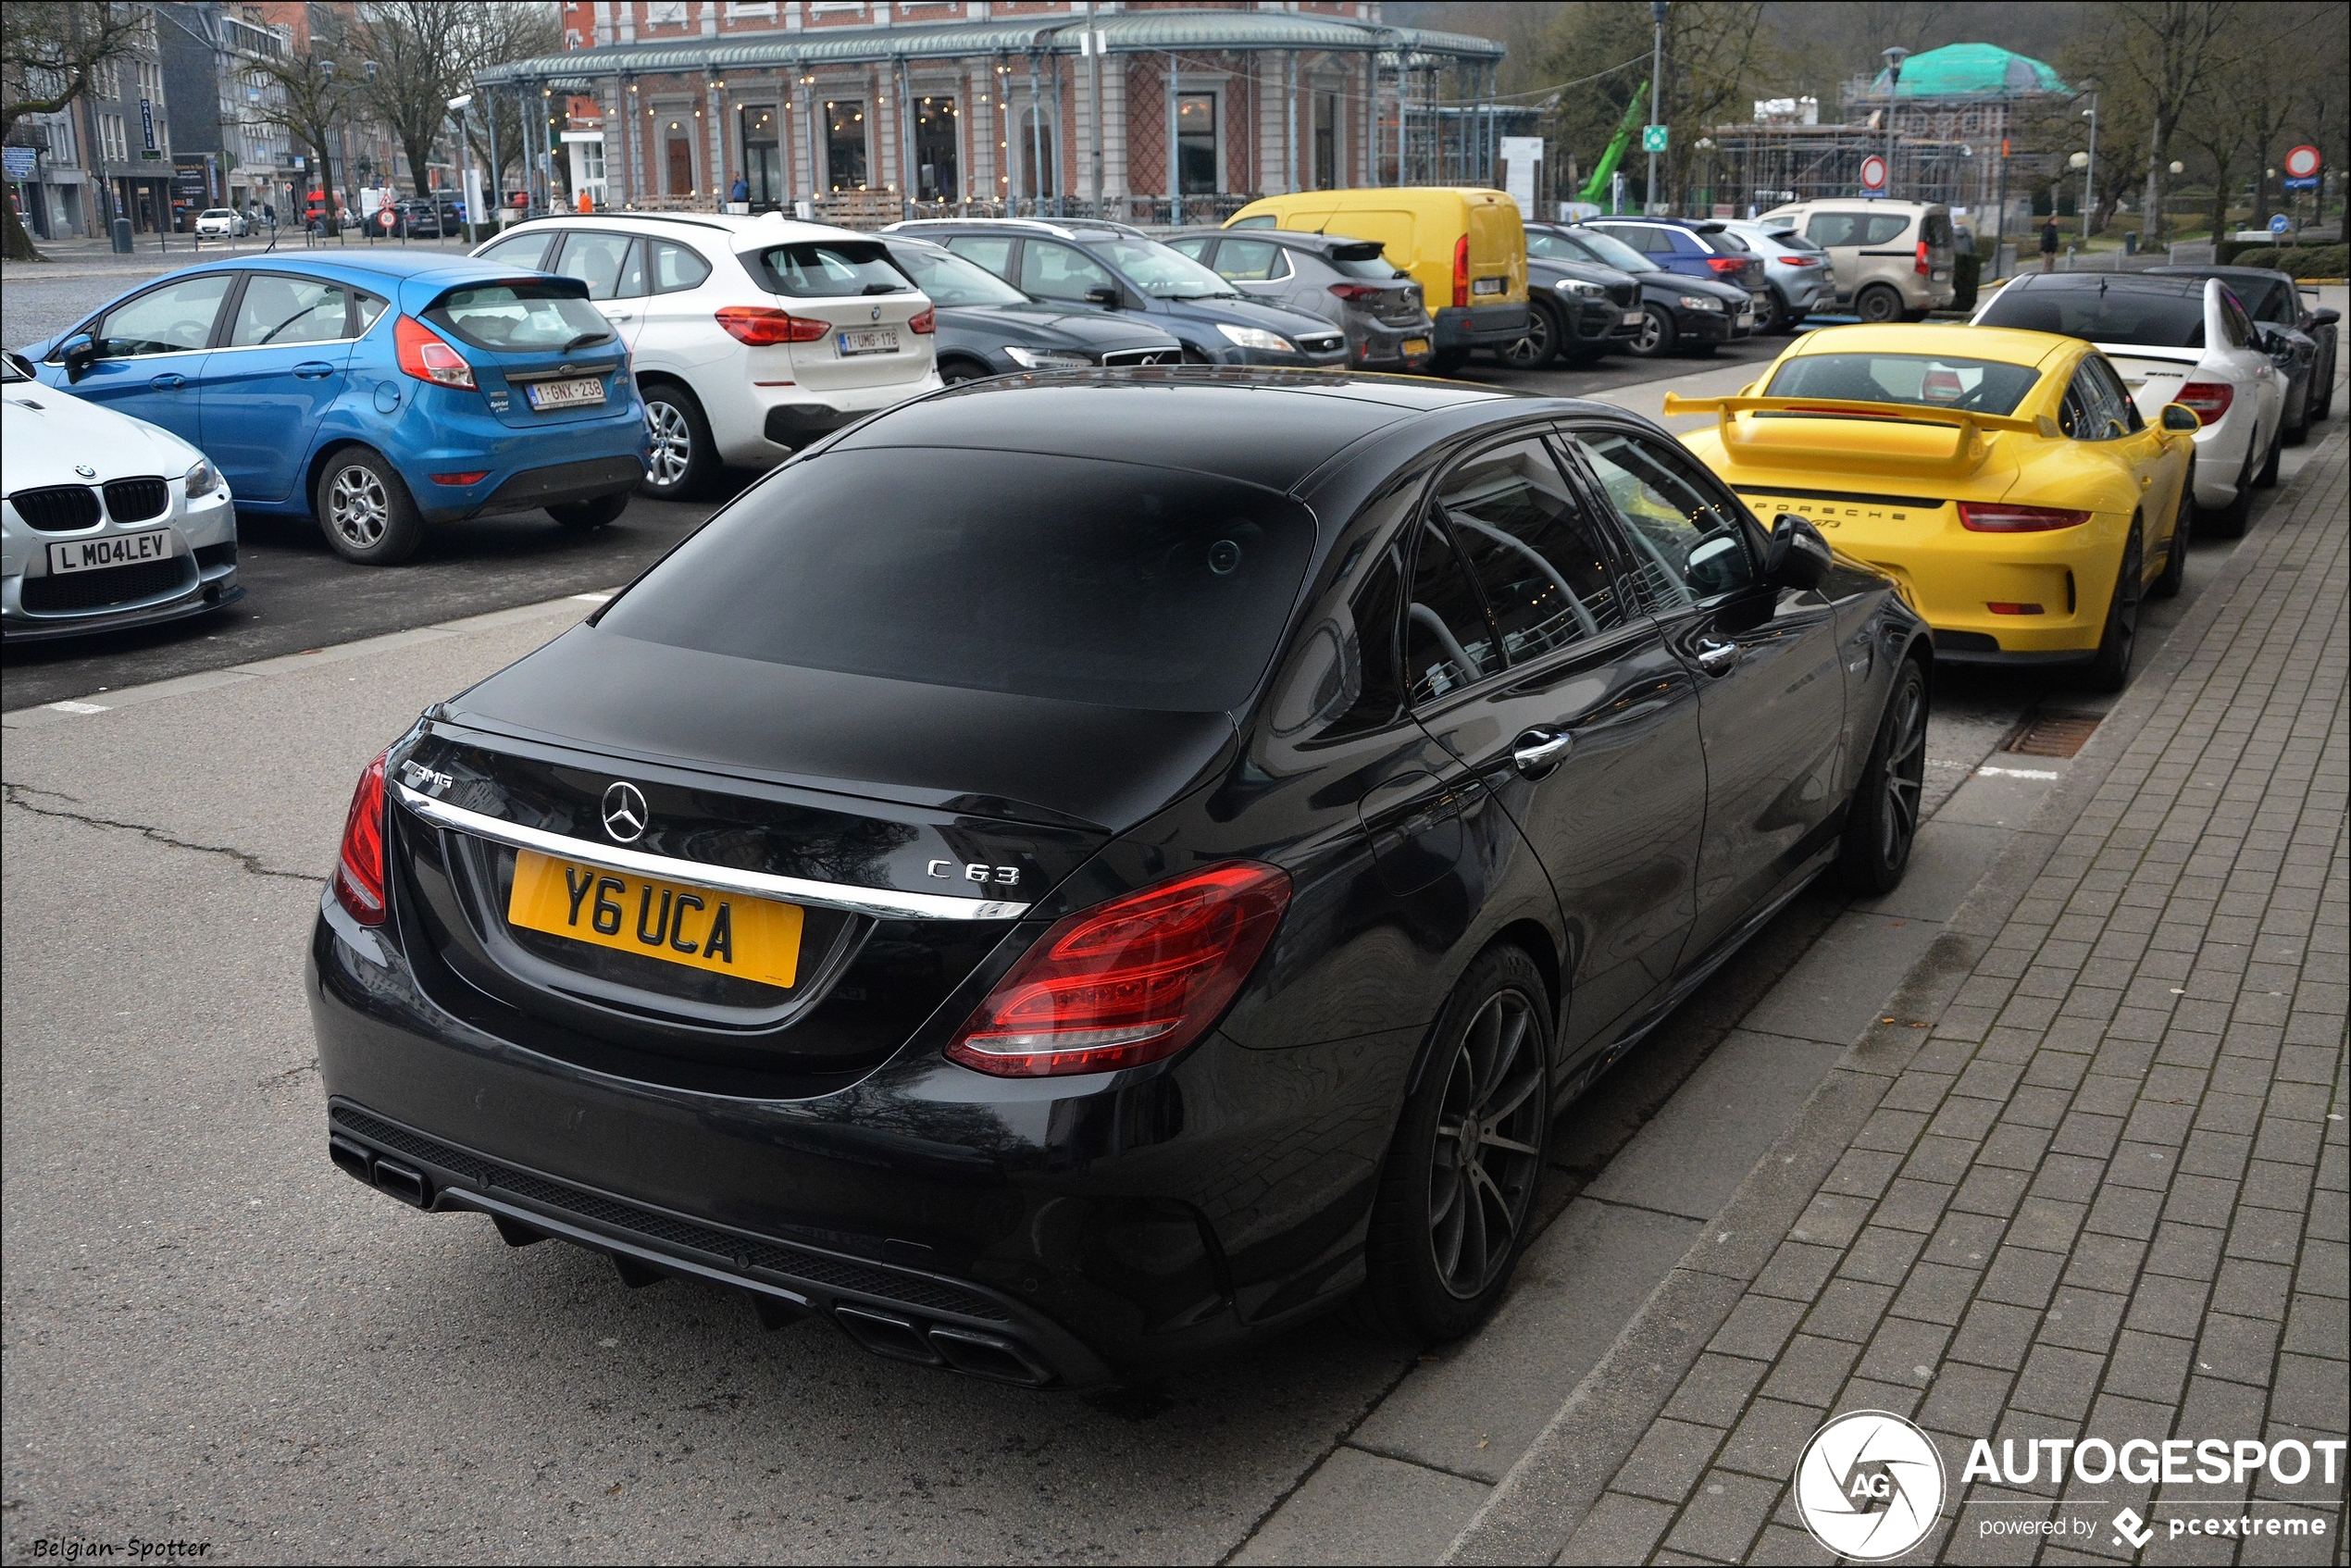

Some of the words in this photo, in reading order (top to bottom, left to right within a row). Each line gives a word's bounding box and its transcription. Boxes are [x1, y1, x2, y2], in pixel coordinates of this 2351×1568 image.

[142, 100, 154, 148] GALERIE
[1754, 503, 1907, 520] PORSCHE
[1811, 518, 1841, 529] GT3
[61, 547, 76, 569] L
[408, 763, 454, 789] AMG
[927, 859, 952, 879] C
[965, 863, 1020, 886] 63
[566, 867, 624, 936] Y6
[636, 884, 734, 964] UCA
